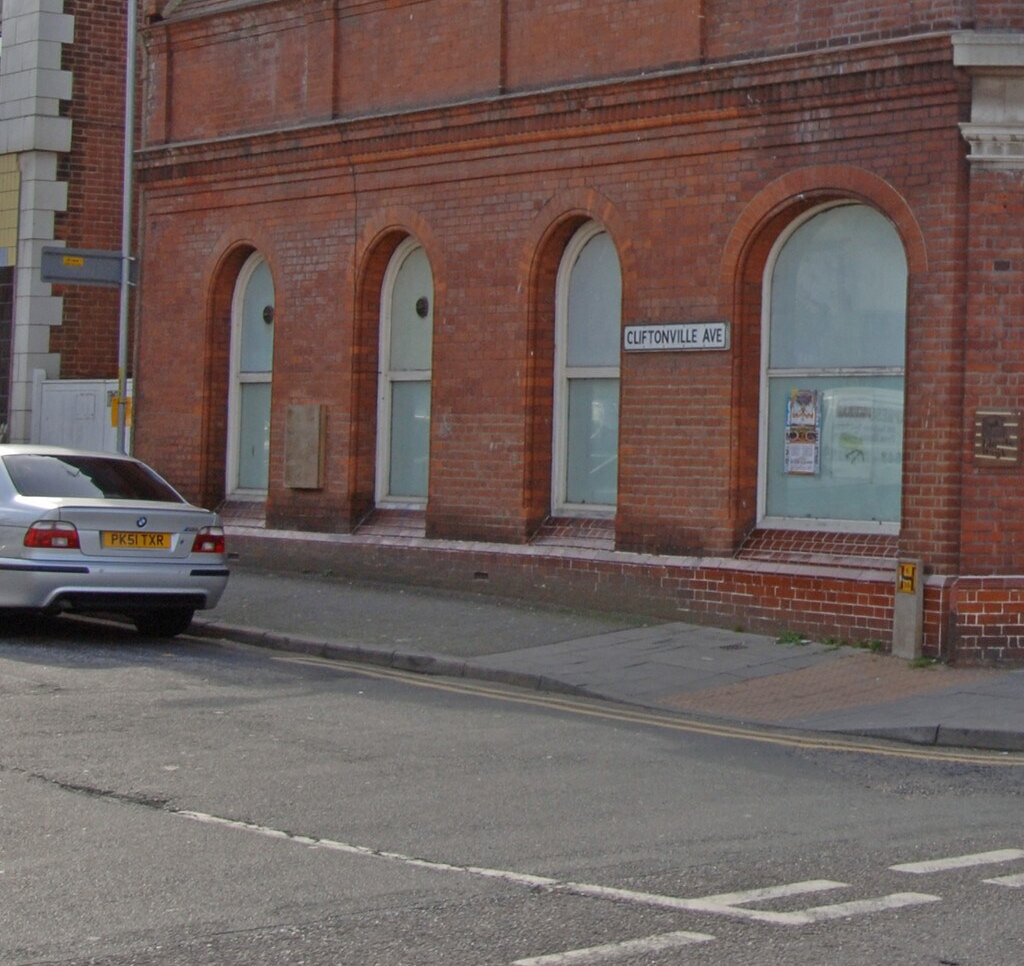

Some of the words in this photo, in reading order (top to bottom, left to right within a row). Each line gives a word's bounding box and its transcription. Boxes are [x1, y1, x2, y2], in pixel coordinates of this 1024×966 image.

[627, 329, 698, 345] CLIFTONVILLE
[702, 328, 723, 343] AVE
[111, 533, 138, 546] PK51
[141, 534, 165, 546] TXR
